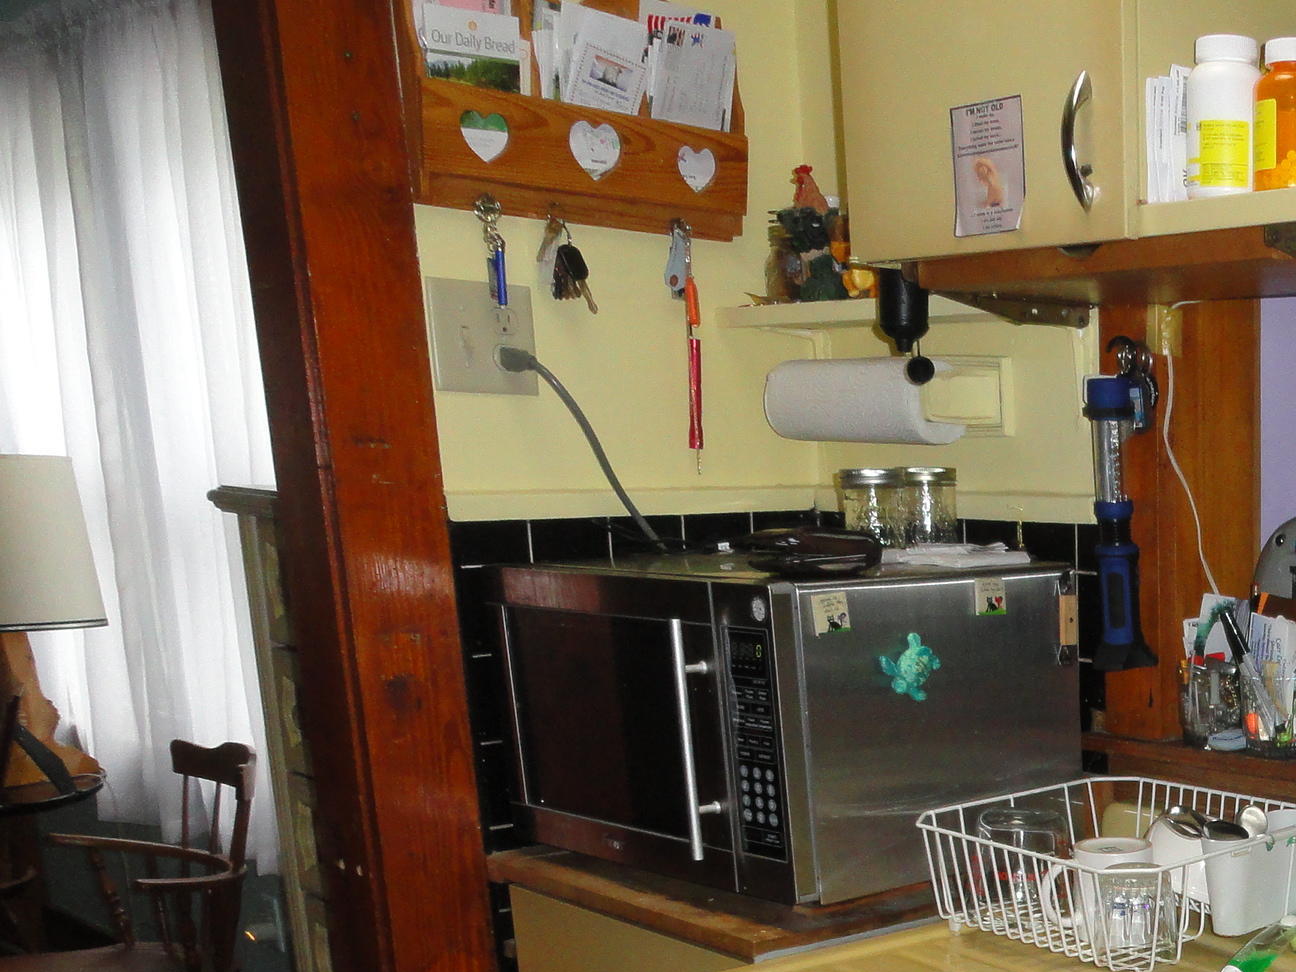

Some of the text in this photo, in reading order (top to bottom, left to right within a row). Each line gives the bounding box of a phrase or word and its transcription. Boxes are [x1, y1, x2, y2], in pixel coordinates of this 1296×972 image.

[431, 29, 515, 54] Our Daily Bread
[976, 105, 989, 115] NOT
[991, 102, 1004, 112] OLD
